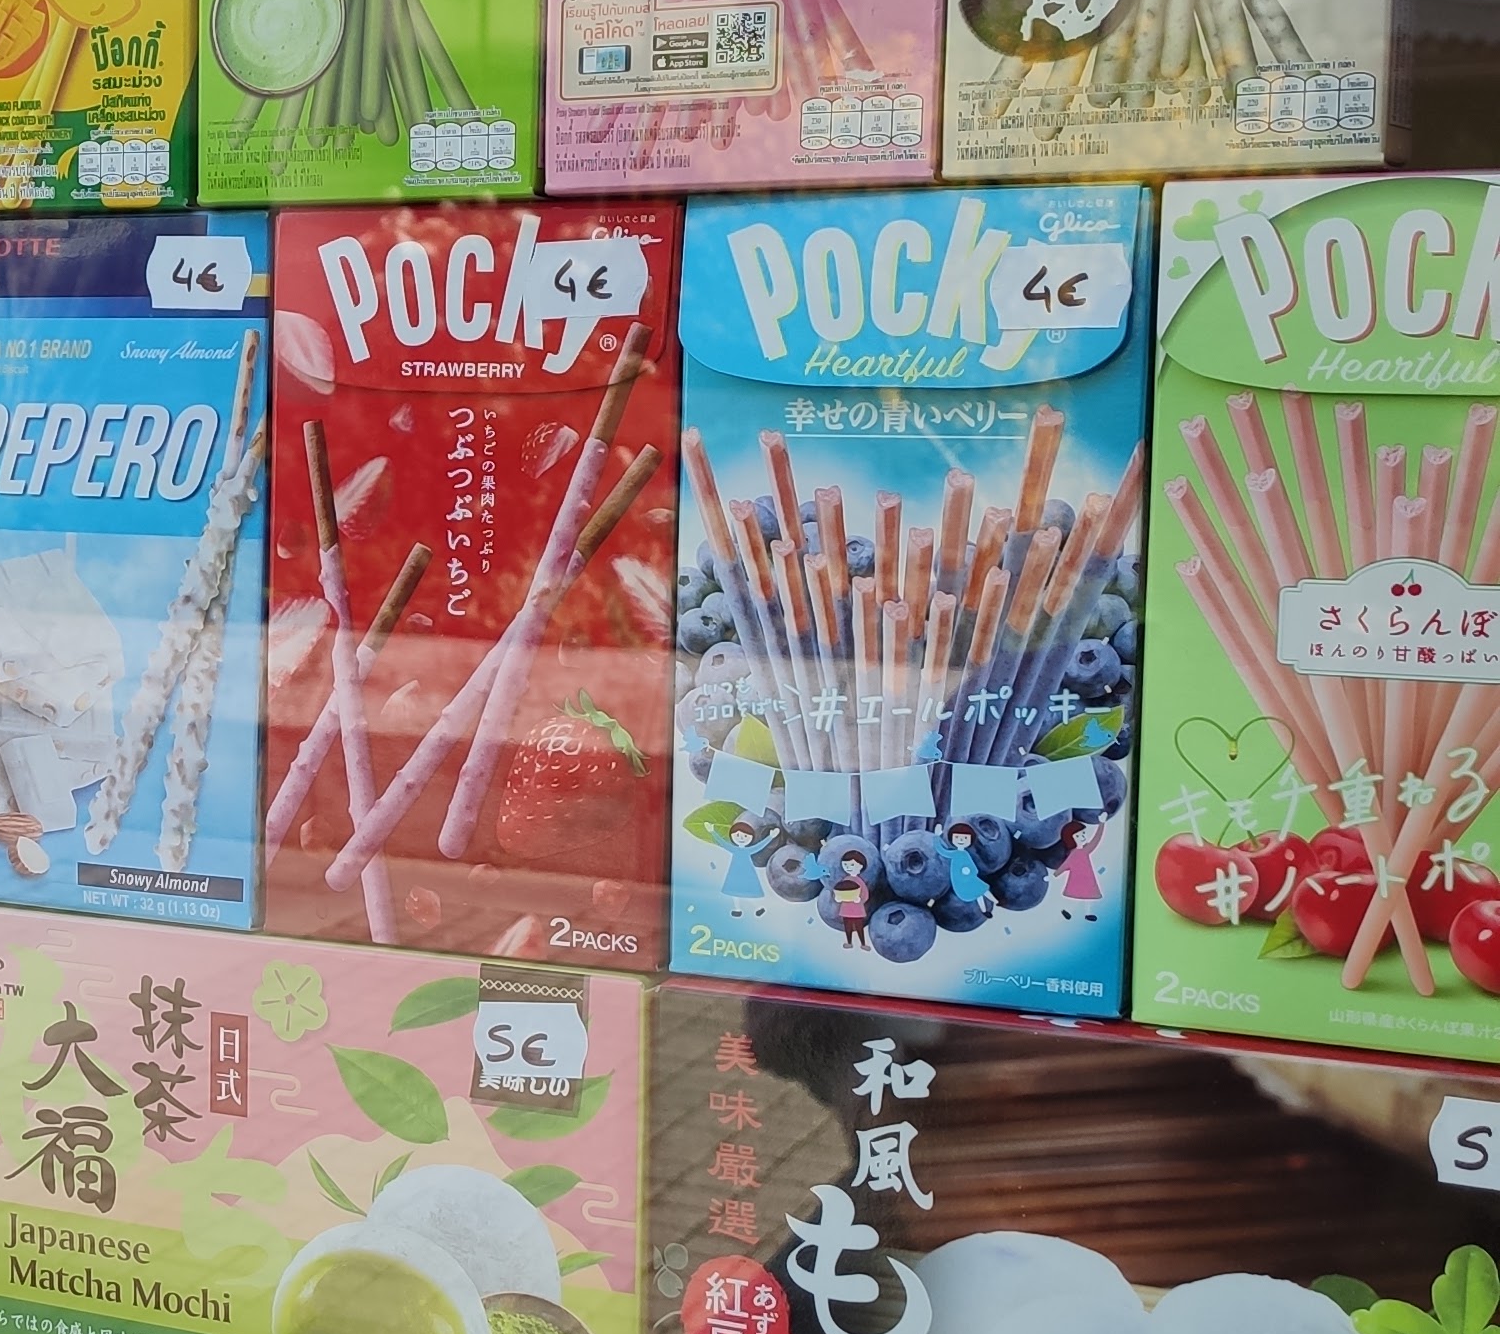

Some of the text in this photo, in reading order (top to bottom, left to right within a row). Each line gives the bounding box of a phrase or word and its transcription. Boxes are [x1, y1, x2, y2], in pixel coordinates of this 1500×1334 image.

[172, 257, 225, 294] 4€
[553, 260, 614, 301] 4€
[1022, 266, 1089, 315] 4€
[120, 339, 237, 362] Snowy Almond
[401, 361, 526, 379] STRAWBERRY
[804, 345, 969, 384] Heartful
[1308, 347, 1500, 390] Heartful
[785, 399, 1028, 433] 幸せの青いベリー
[448, 406, 475, 618] つぶつぶいちご
[109, 869, 209, 894] Snowy Almond
[549, 918, 638, 955] 2PACKS
[689, 924, 780, 963] 2PACKS
[965, 969, 1104, 998] ブルーベリー香料使用
[1154, 971, 1260, 1014] 2PACKS
[129, 974, 204, 1145] 抹茶
[214, 1025, 243, 1108] 日式
[486, 1024, 557, 1068] 5€
[5, 1001, 128, 1214] 大福
[5, 1212, 151, 1266] Japanese
[8, 1258, 232, 1325] Matcha Mochi
